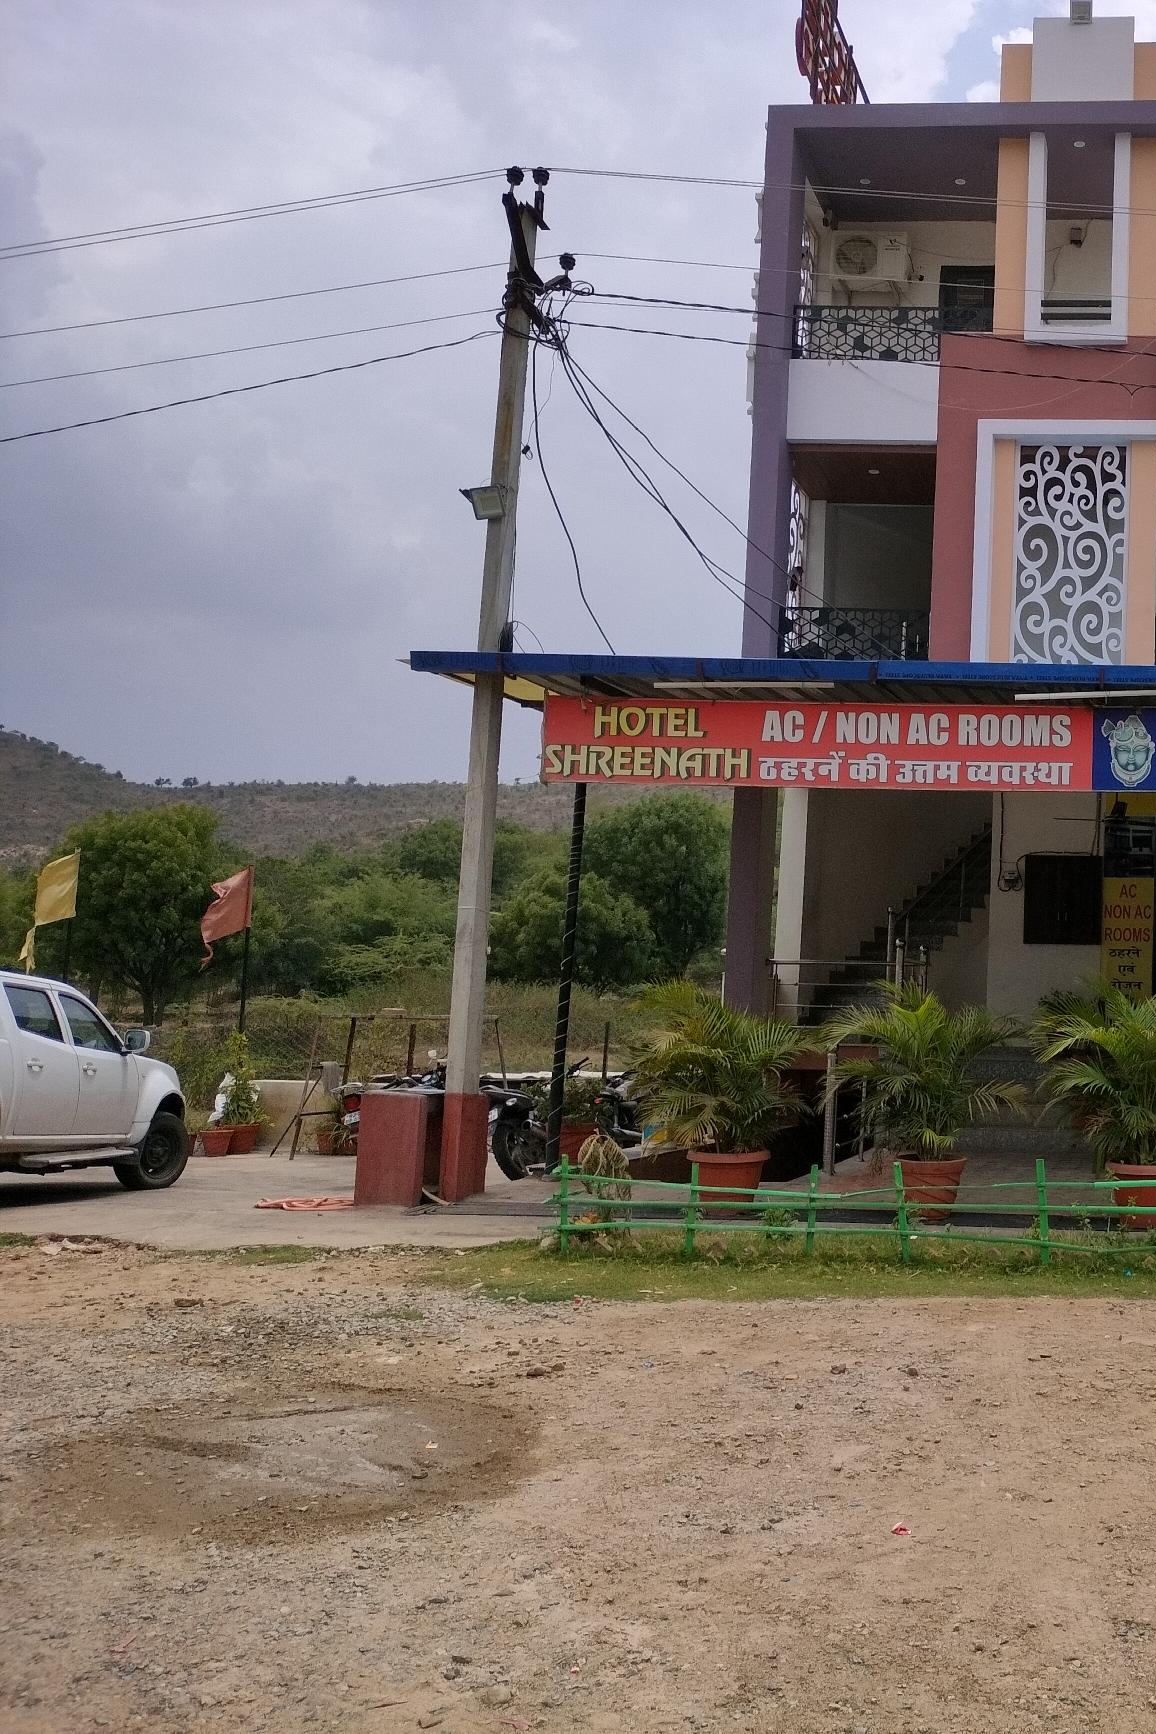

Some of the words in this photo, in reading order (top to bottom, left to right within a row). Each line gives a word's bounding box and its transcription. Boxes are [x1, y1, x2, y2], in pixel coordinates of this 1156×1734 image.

[594, 706, 706, 738] HOTEL
[761, 710, 805, 743] AC
[835, 711, 900, 745] NON
[906, 713, 950, 746] AC
[958, 713, 1073, 748] ROOMS
[544, 744, 751, 780] SHREENATH
[758, 750, 847, 782] ठहरनें
[847, 752, 891, 783] की
[894, 760, 962, 785] उत्तम
[965, 761, 1074, 786] व्यवस्था
[1119, 883, 1137, 899] AC
[1104, 904, 1131, 920] NON
[1134, 904, 1152, 920] AC
[1104, 927, 1151, 942] ROOMS
[1109, 945, 1142, 959] ठहरने
